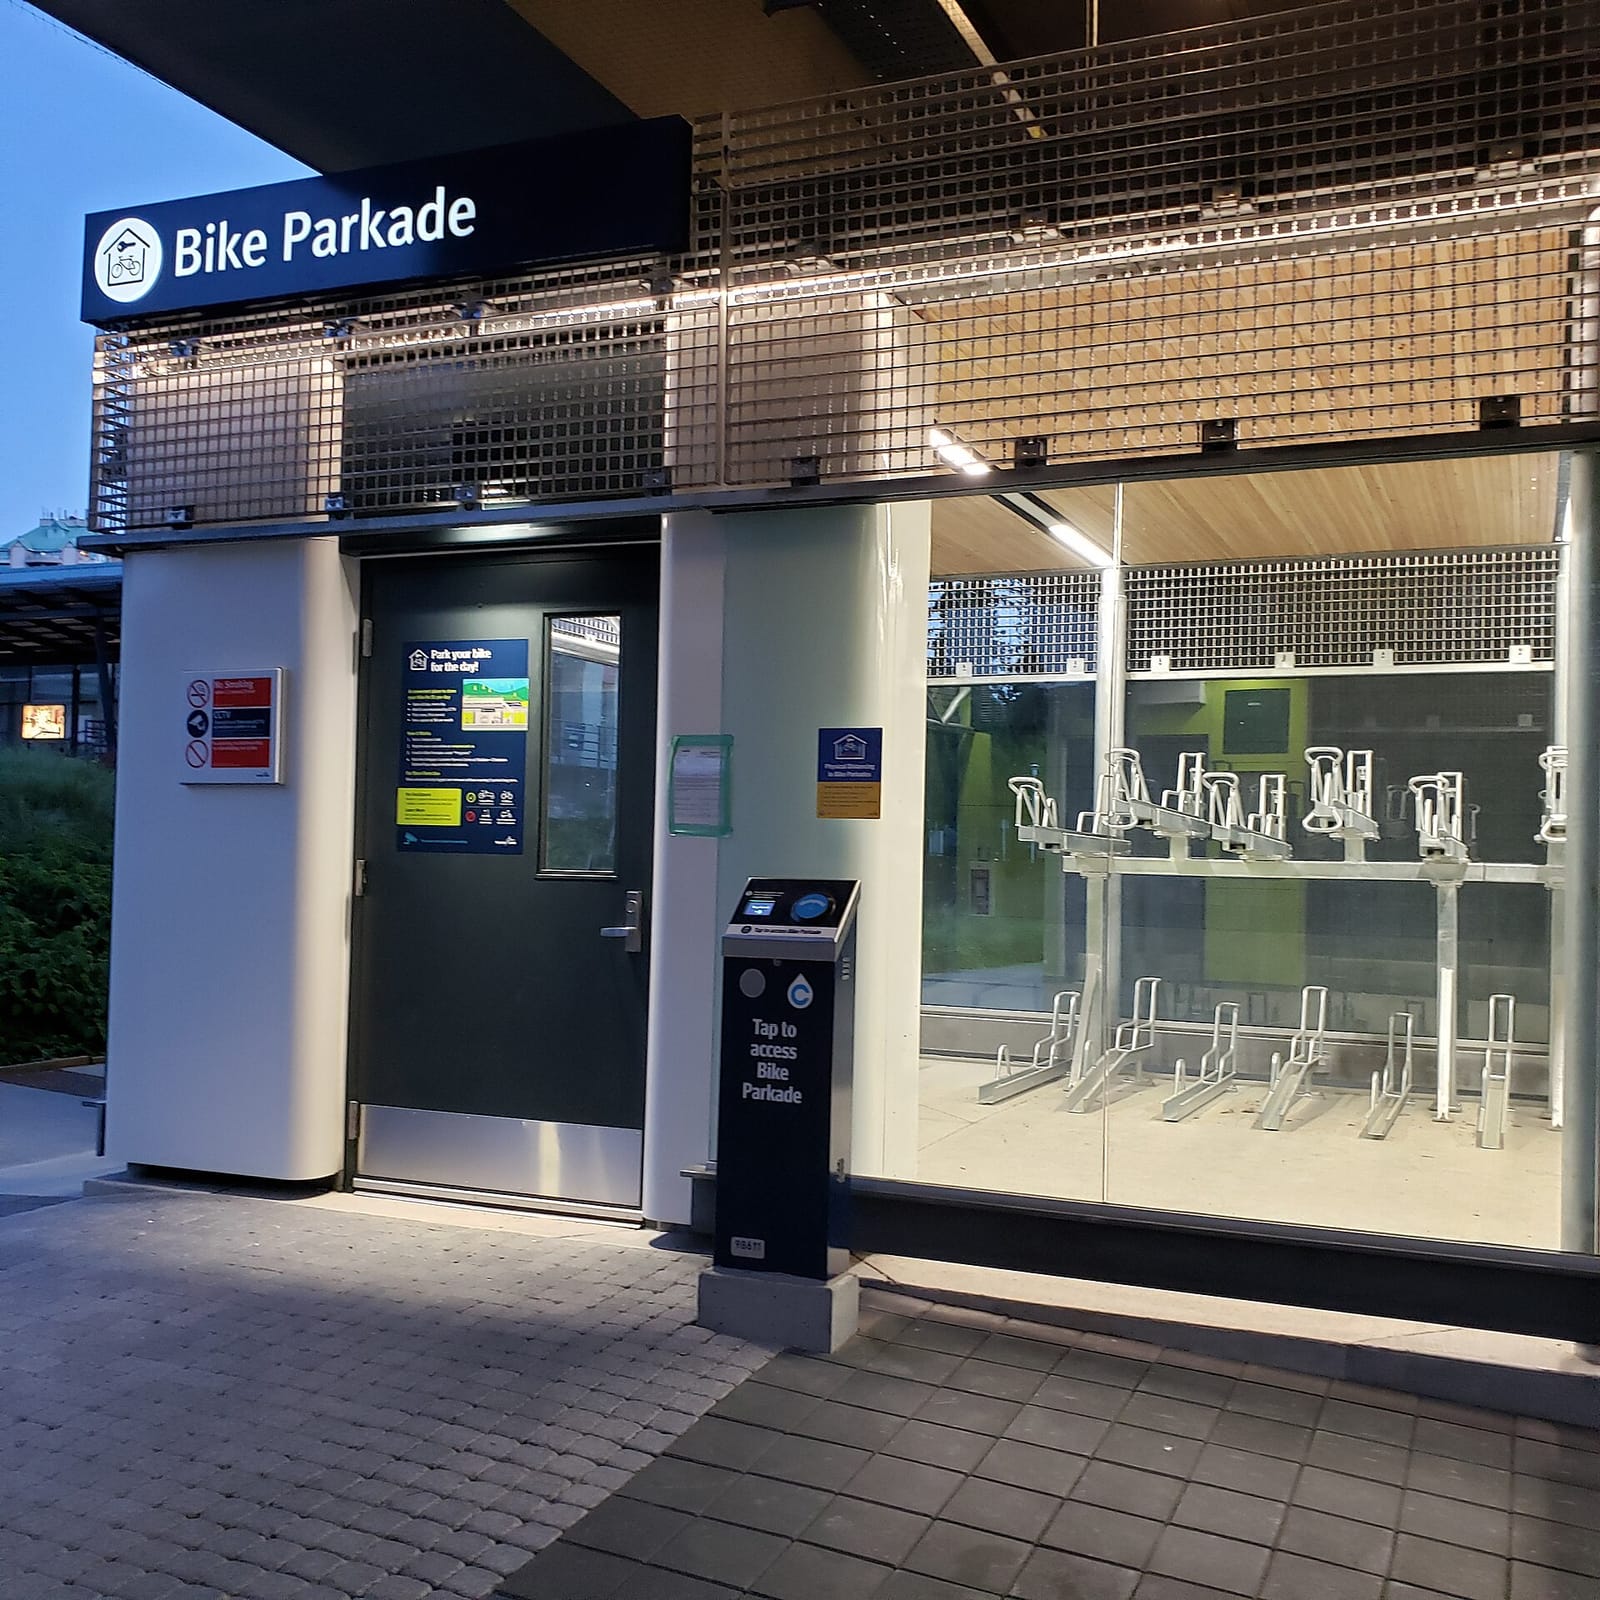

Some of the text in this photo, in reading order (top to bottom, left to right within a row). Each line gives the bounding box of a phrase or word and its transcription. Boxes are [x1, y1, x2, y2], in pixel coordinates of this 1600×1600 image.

[175, 186, 477, 277] Bike Parkade
[430, 647, 493, 661] Park your bike
[430, 661, 443, 672] for
[444, 661, 459, 672] the
[752, 1018, 798, 1040] Tap to
[750, 1044, 798, 1060] access
[757, 1062, 789, 1081] Bike
[742, 1082, 803, 1104] Parkade
